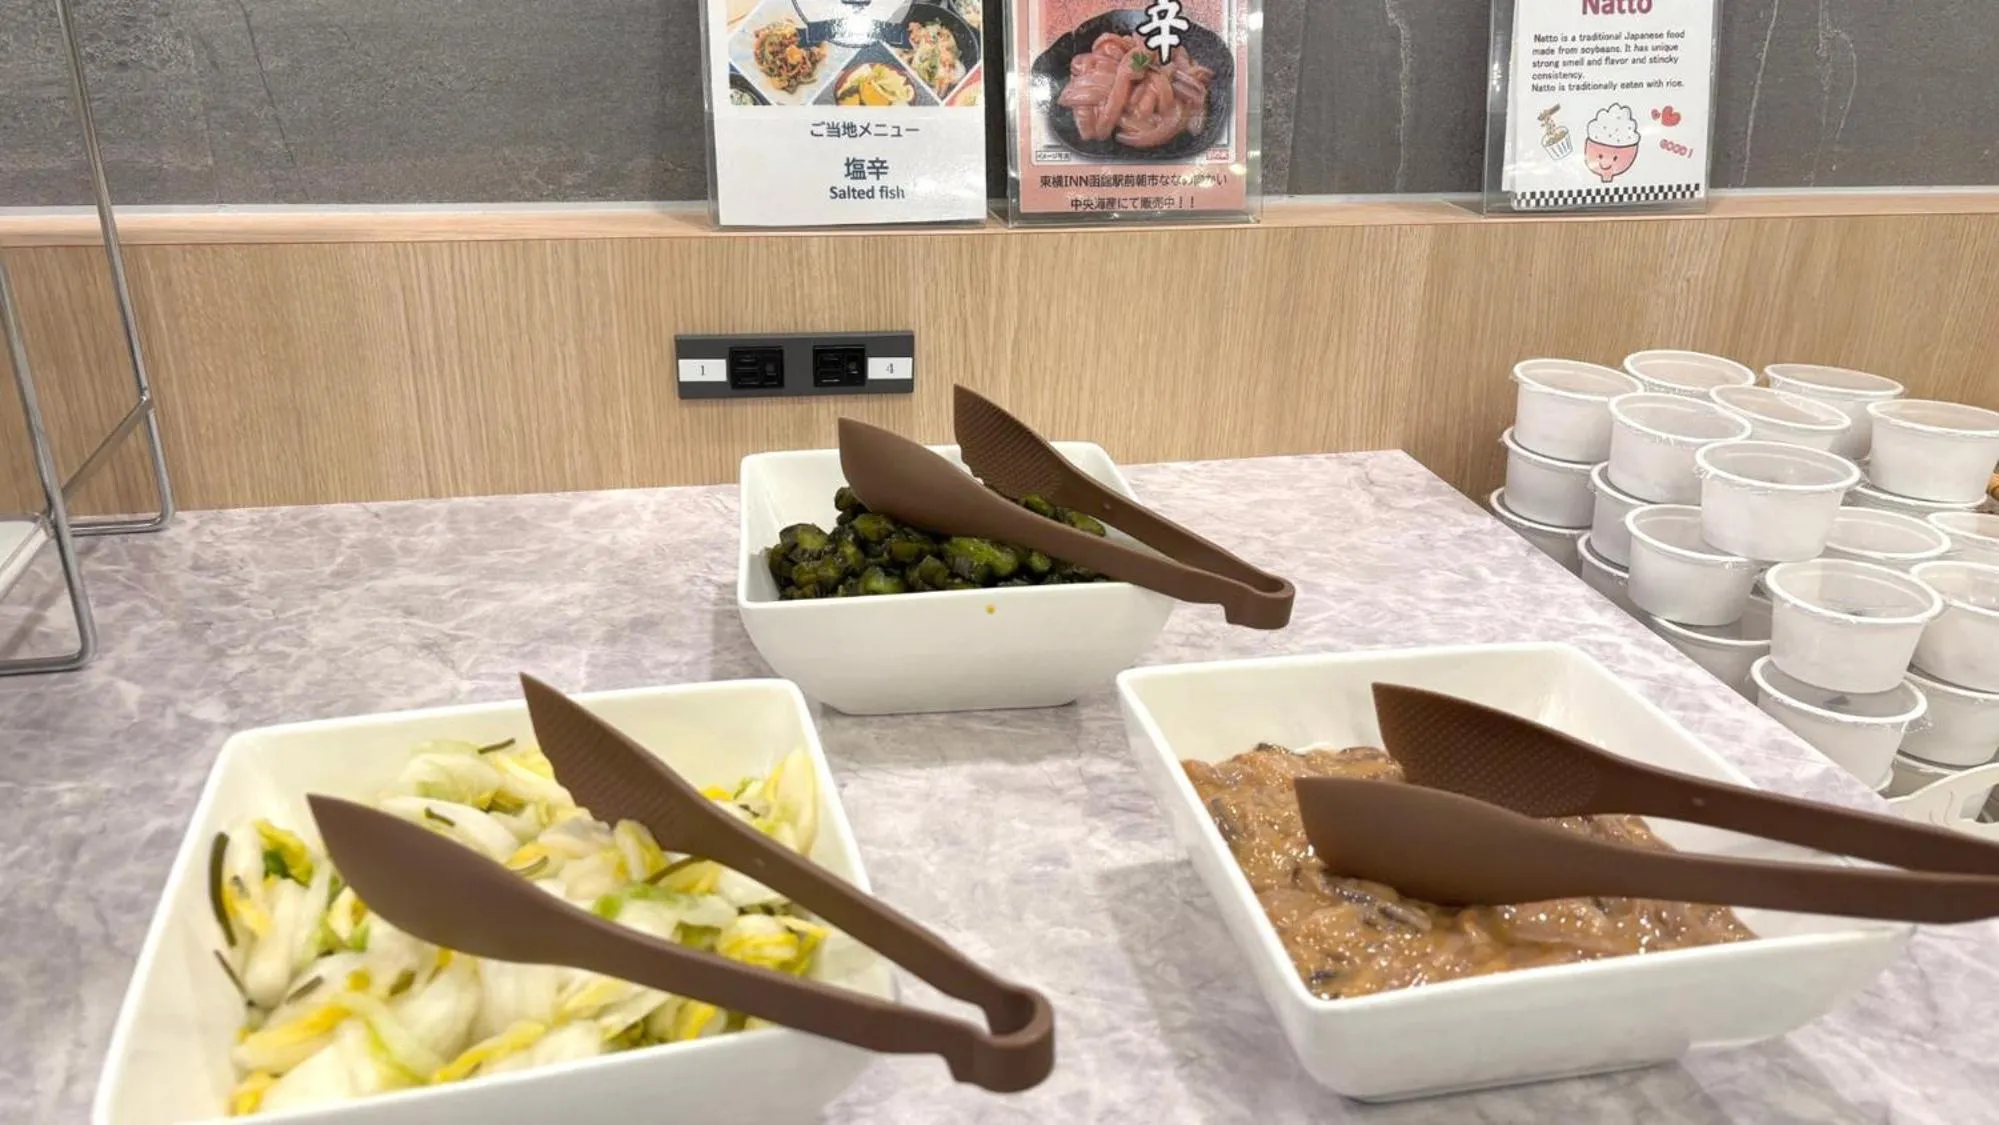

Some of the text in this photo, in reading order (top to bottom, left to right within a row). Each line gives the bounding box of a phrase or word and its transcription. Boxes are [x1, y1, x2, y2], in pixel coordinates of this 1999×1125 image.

[1582, 0, 1653, 15] Natto
[1533, 33, 1559, 43] Natto
[1561, 33, 1568, 42] is
[1579, 32, 1622, 42] traditional
[1625, 31, 1664, 41] Japanese
[1667, 30, 1685, 39] food
[1532, 47, 1556, 55] made
[1558, 46, 1578, 55] from
[1625, 44, 1631, 53] It
[1634, 44, 1648, 53] has
[1651, 42, 1678, 53] unique
[1532, 60, 1559, 68] strong
[1562, 58, 1584, 67] smell
[1587, 57, 1602, 66] and
[1604, 56, 1628, 66] flavor
[1631, 56, 1647, 65] and
[1532, 70, 1585, 81] consistency.
[1531, 79, 1684, 92] Natto is traditionally eaten with rice.
[810, 121, 920, 138] ご当地メニュー
[844, 156, 889, 180] 塩辛
[829, 185, 905, 199] Salted fish
